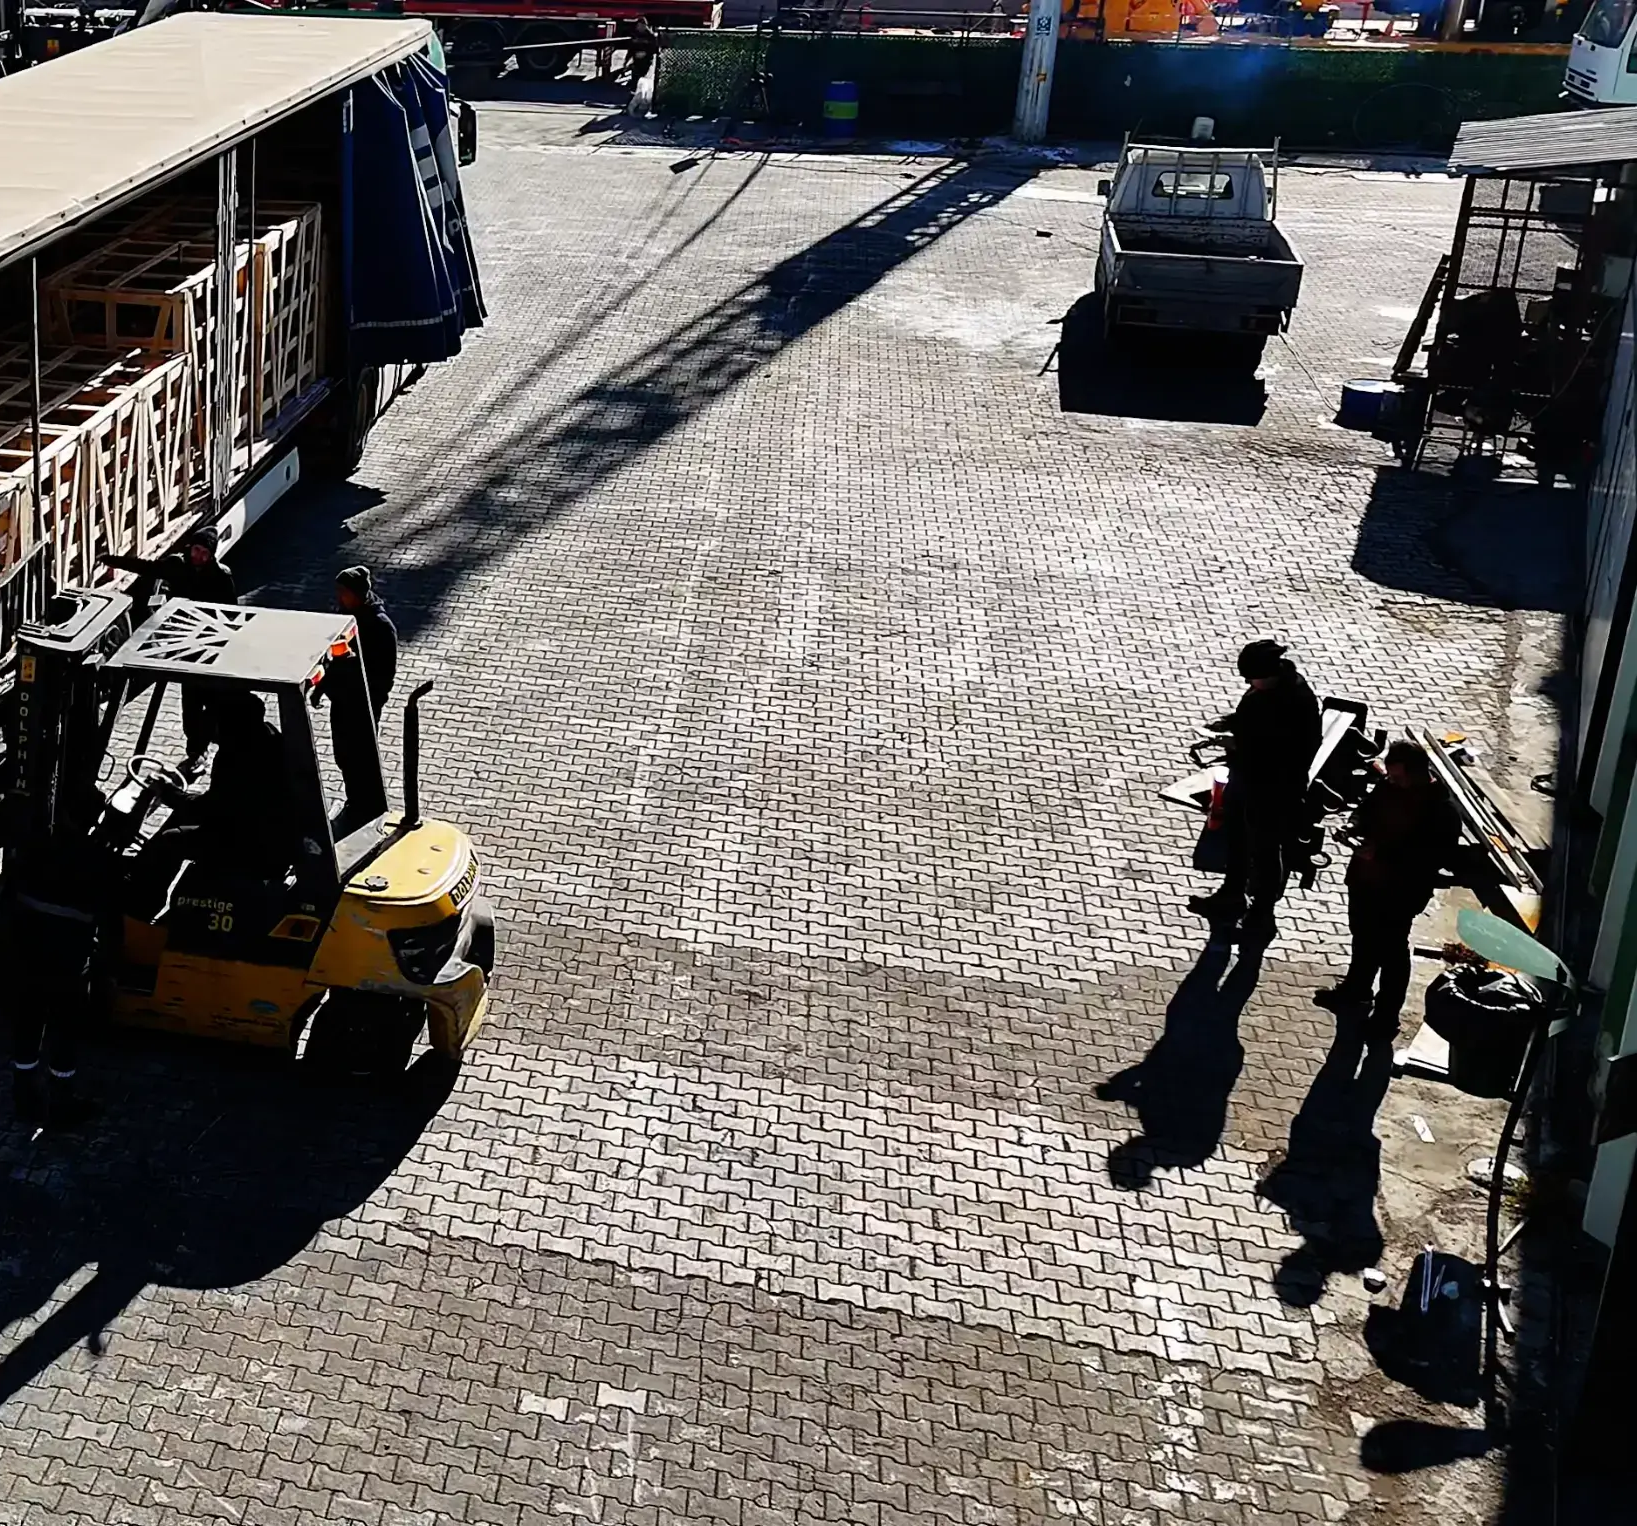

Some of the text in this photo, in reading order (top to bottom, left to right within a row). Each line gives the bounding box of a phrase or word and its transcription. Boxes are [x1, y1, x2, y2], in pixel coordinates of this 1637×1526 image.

[16, 691, 30, 789] DOLPHIN
[177, 896, 234, 913] prestige
[207, 913, 233, 932] 30
